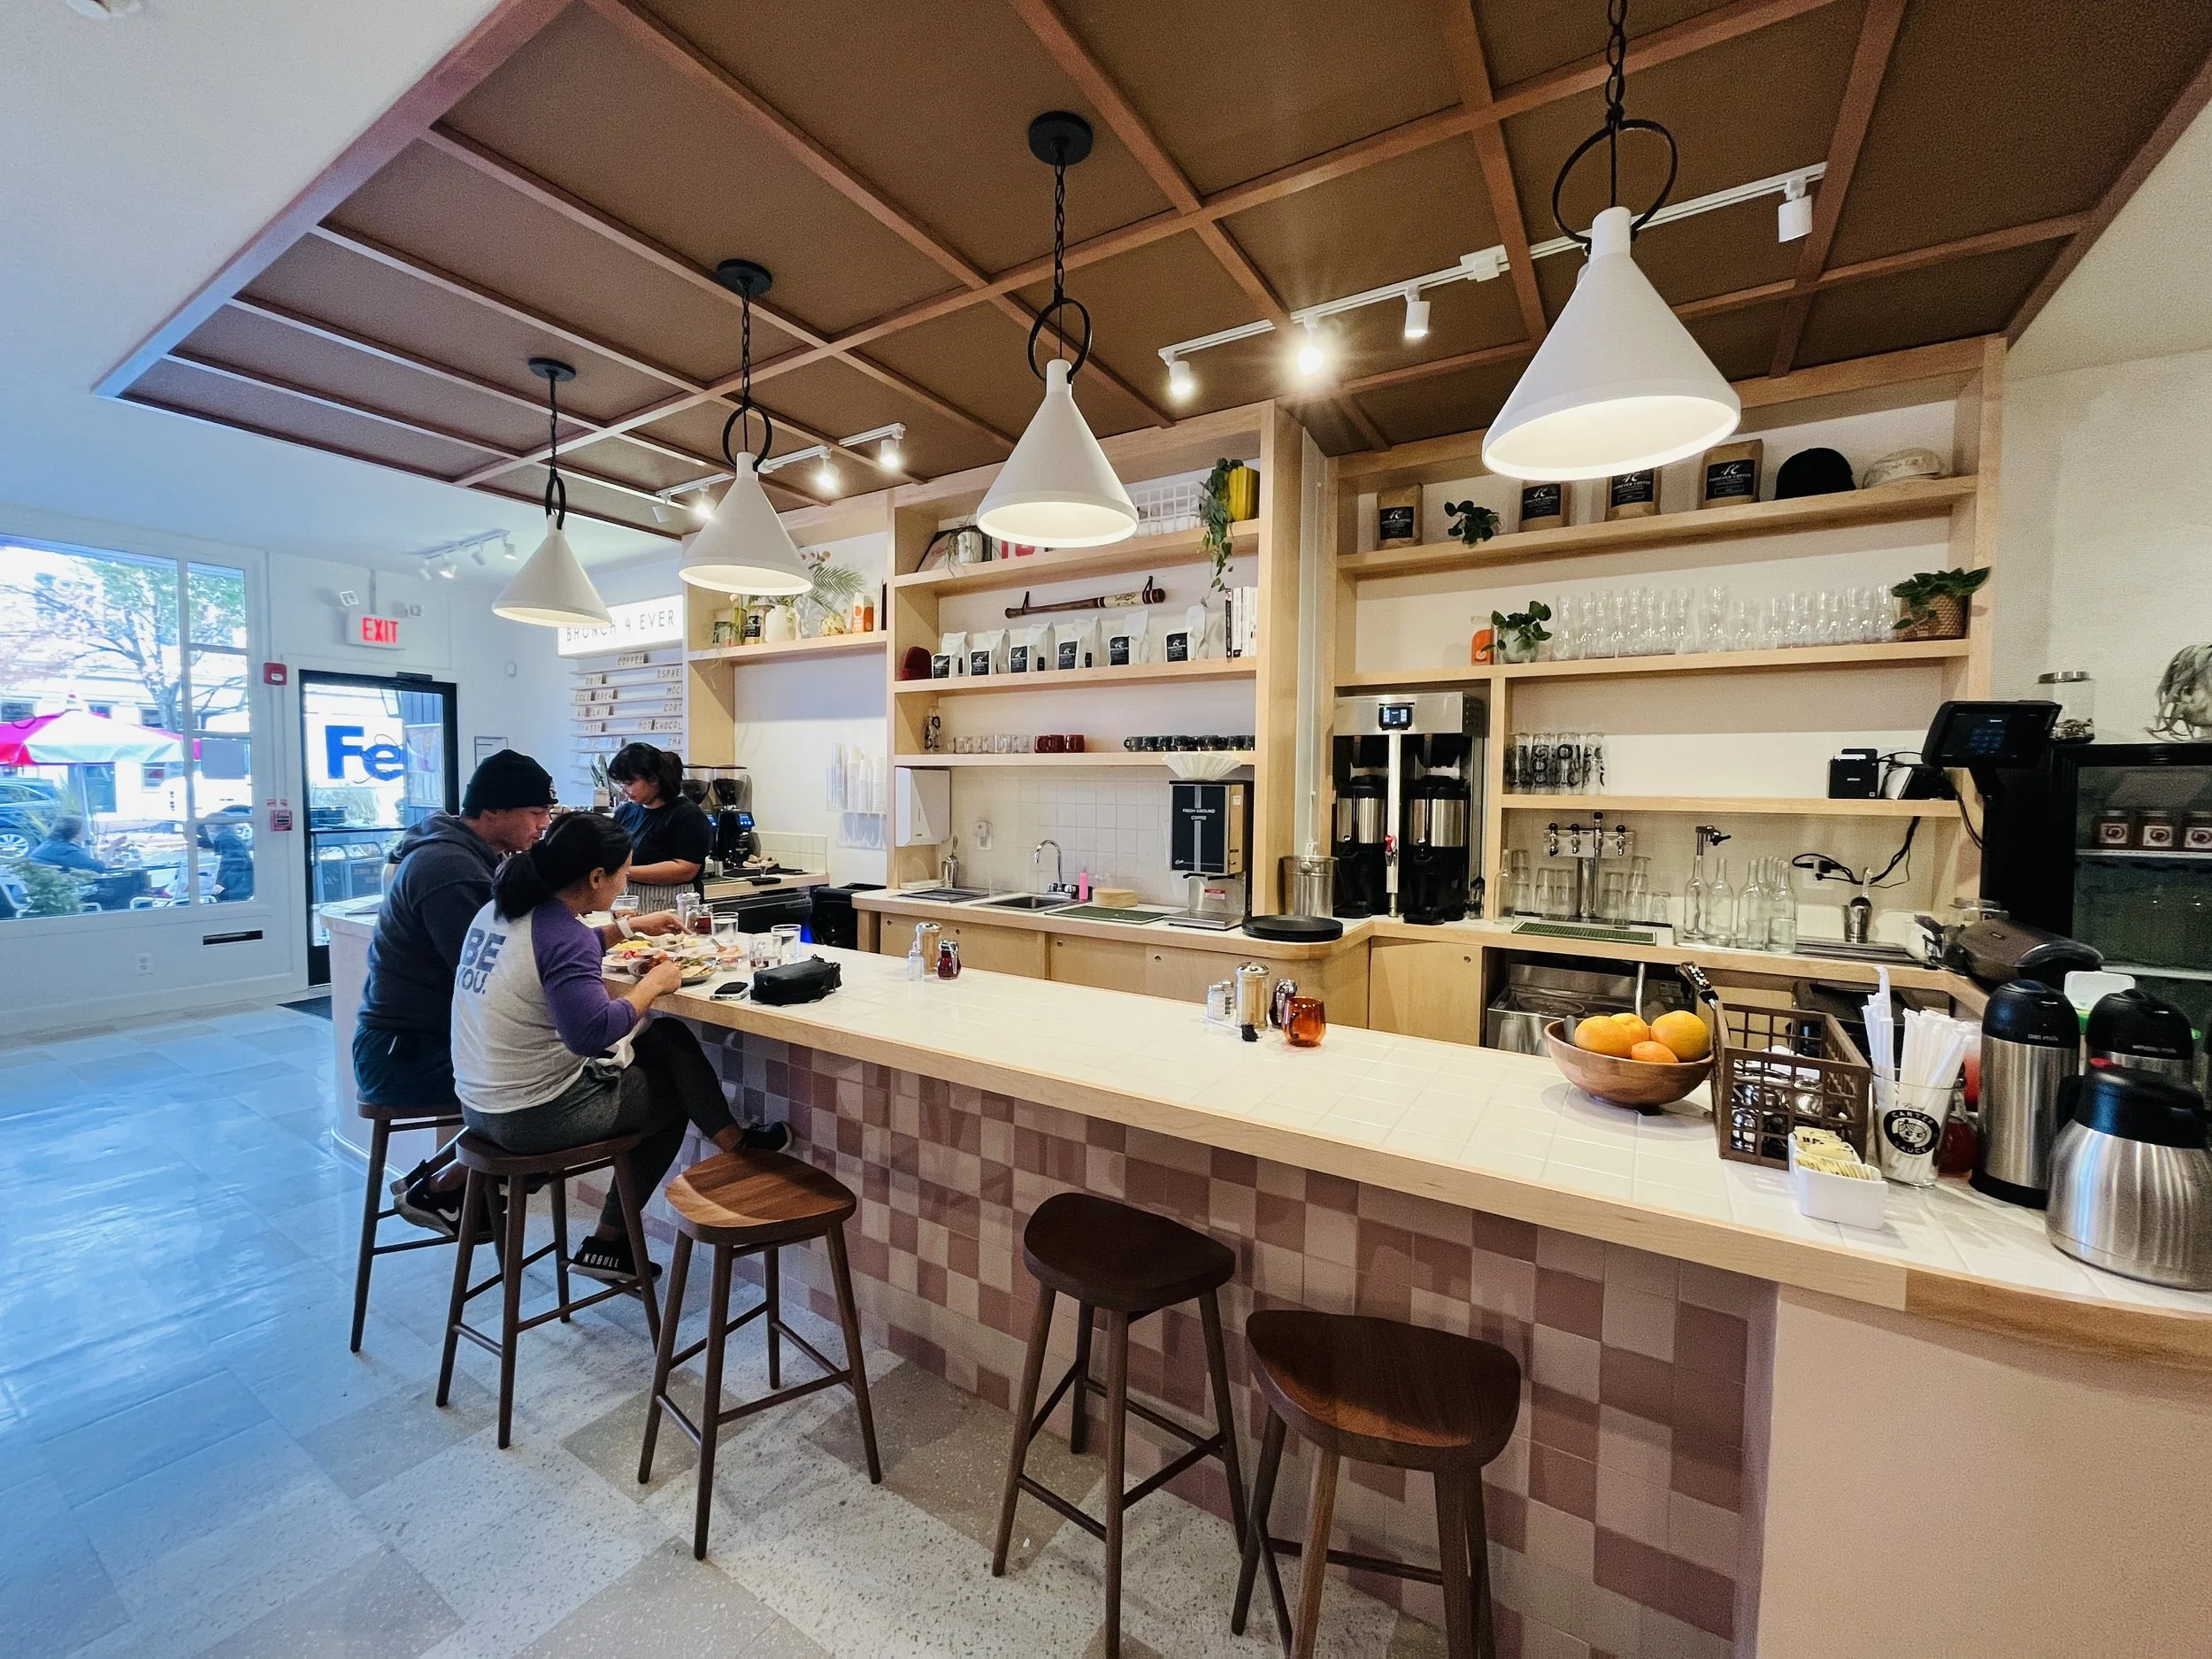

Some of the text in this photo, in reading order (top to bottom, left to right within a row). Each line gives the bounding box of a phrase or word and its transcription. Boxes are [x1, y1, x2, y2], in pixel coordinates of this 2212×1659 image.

[626, 617, 631, 631] 4
[640, 610, 674, 630] EVER
[361, 617, 398, 644] EXIT
[618, 656, 643, 666] COFFEE
[657, 669, 680, 679] ESPRE
[639, 721, 651, 730] HOT
[325, 725, 404, 781] Fe
[461, 927, 506, 972] BE
[1892, 1110, 1935, 1125] CARTER
[1893, 1141, 1928, 1154] SAUCE
[582, 1253, 619, 1268] NOBULL
